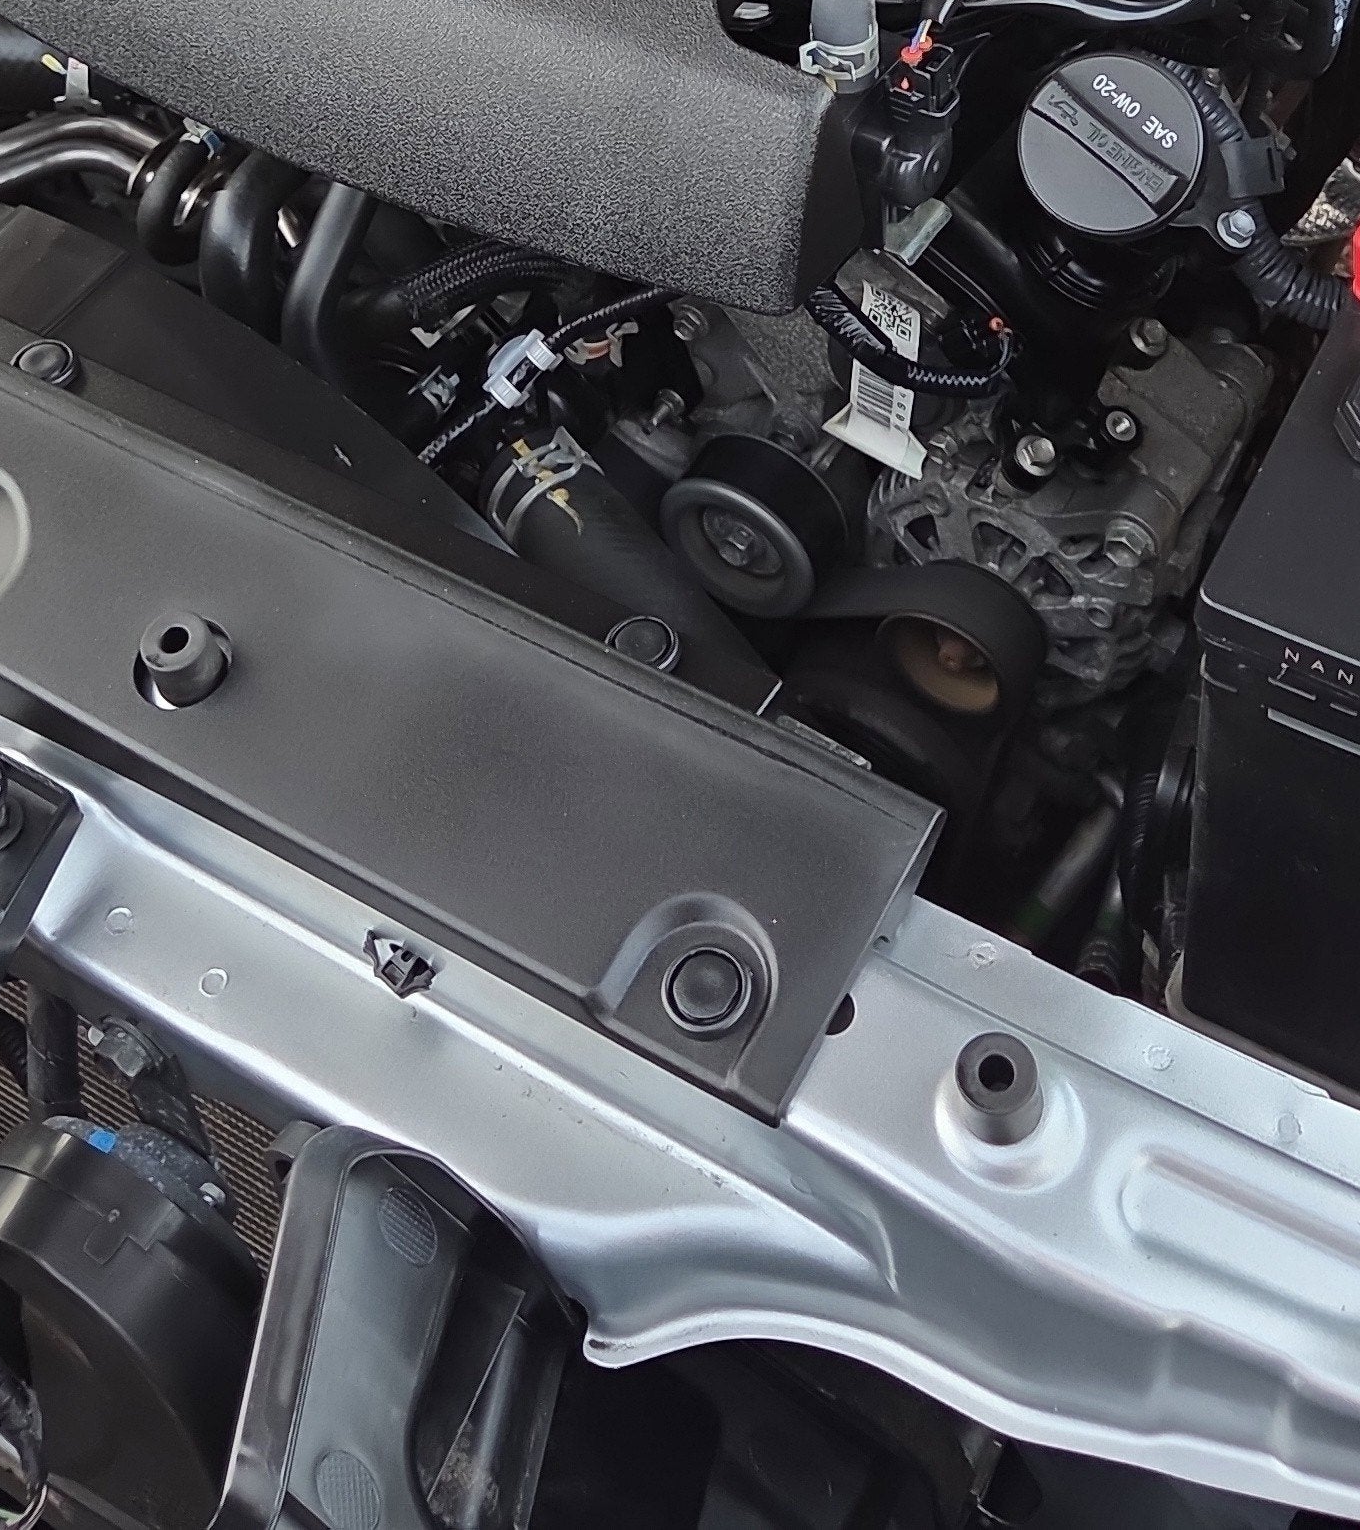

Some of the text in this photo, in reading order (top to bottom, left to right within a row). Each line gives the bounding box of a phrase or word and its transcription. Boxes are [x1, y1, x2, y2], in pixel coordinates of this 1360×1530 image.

[1092, 74, 1177, 148] SAE 0W-20
[1079, 120, 1165, 194] ENGINE OIL
